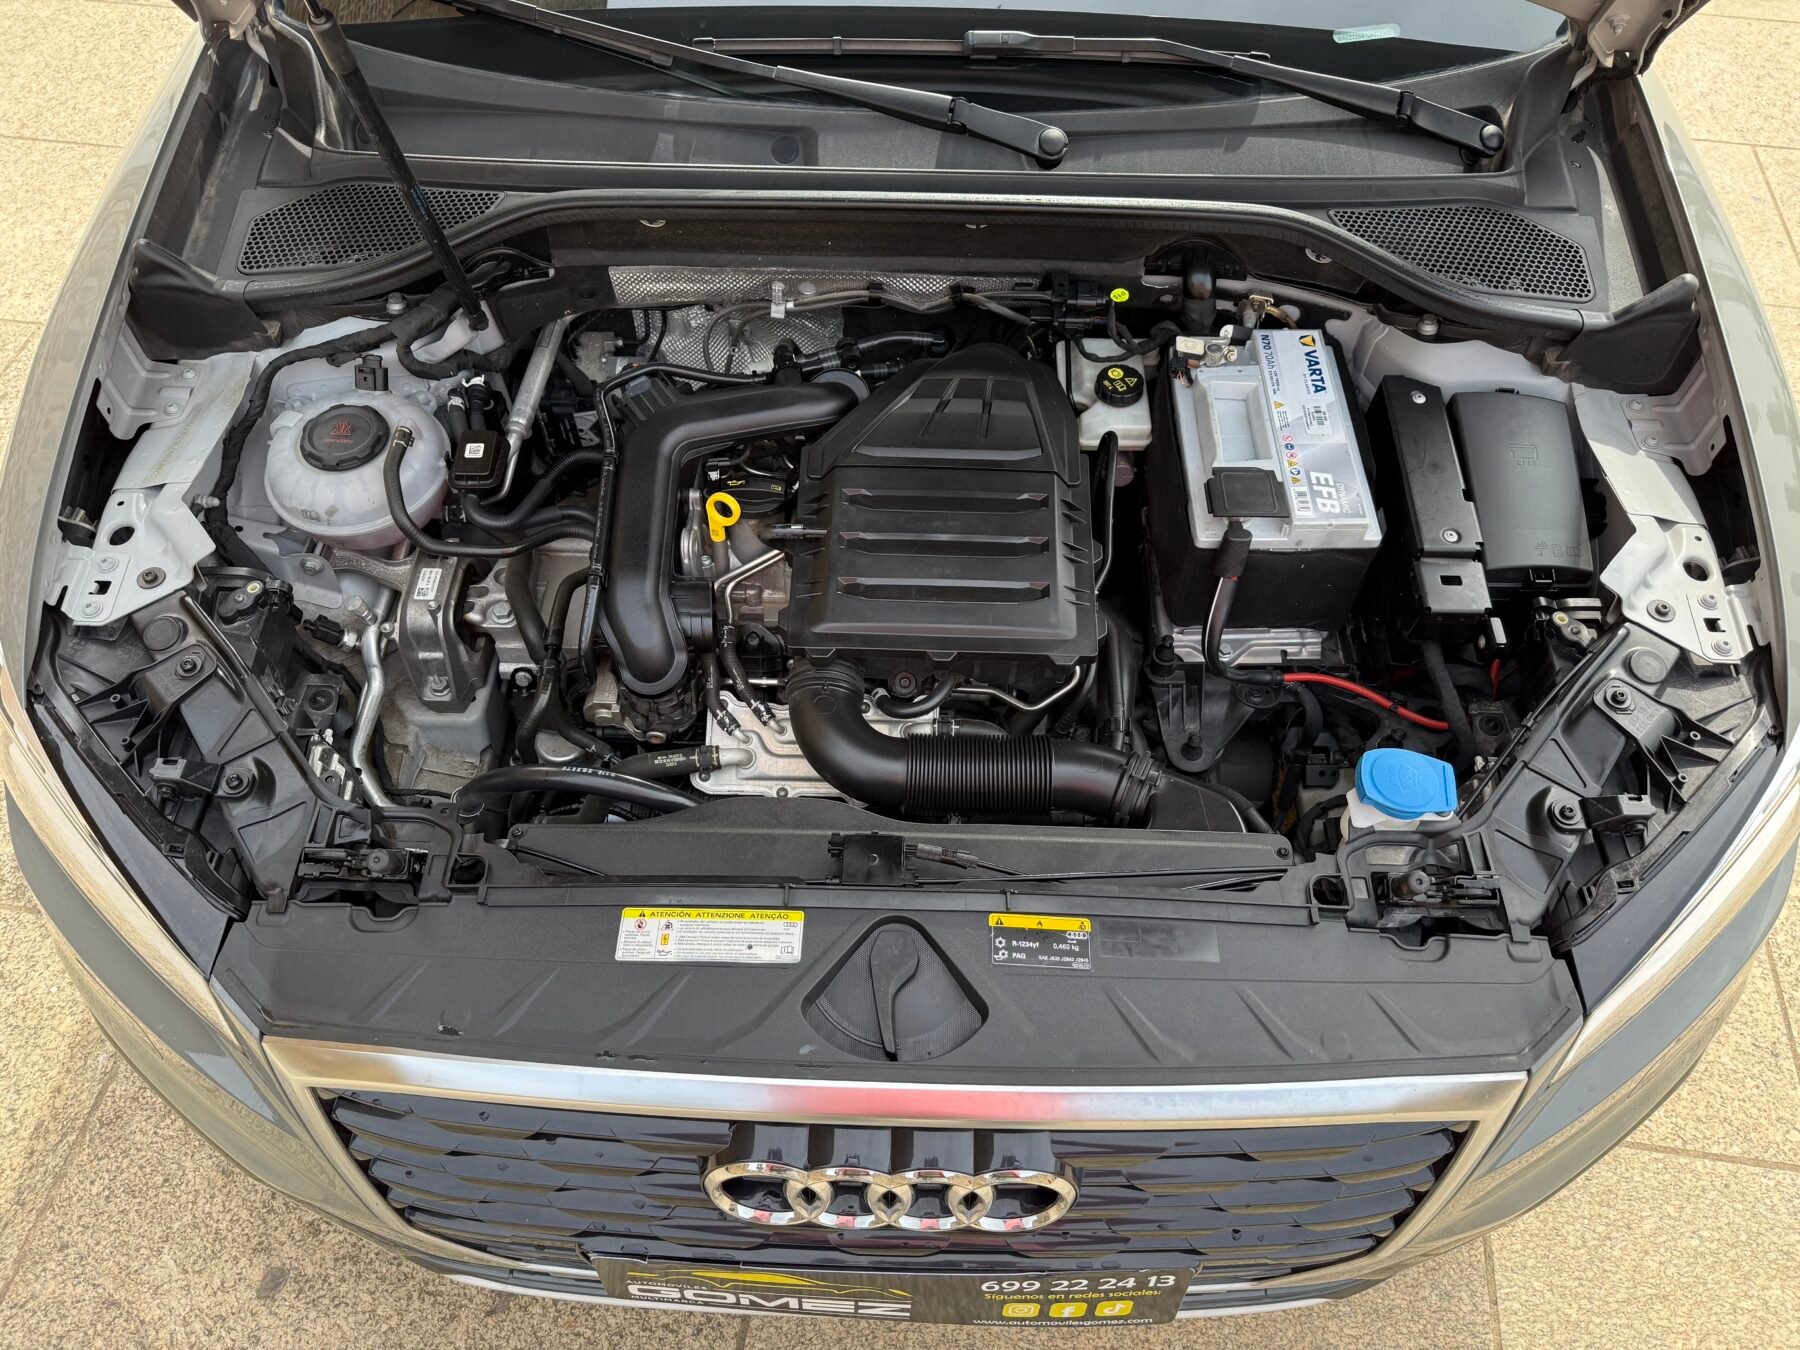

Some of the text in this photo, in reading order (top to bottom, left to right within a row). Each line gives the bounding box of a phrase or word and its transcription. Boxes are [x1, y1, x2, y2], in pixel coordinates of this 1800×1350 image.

[1261, 334, 1272, 350] N70
[1264, 351, 1276, 370] 70Ah
[1304, 349, 1327, 394] VARTA
[1310, 471, 1341, 514] EFB
[750, 912, 789, 920] ATENÇÃO
[1012, 940, 1039, 949] R-1234yf
[625, 1279, 708, 1290] AUTOMOVILES
[980, 1275, 1176, 1292] 699 22 24 13
[627, 1284, 912, 1317] GOMEZ
[631, 1294, 704, 1305] MULTIMARCA
[984, 1292, 1044, 1301] Síguenos
[1069, 1291, 1105, 1299] redes
[1108, 1289, 1161, 1298] sociales:
[973, 1318, 1153, 1327] www.automovilesgomez.com
